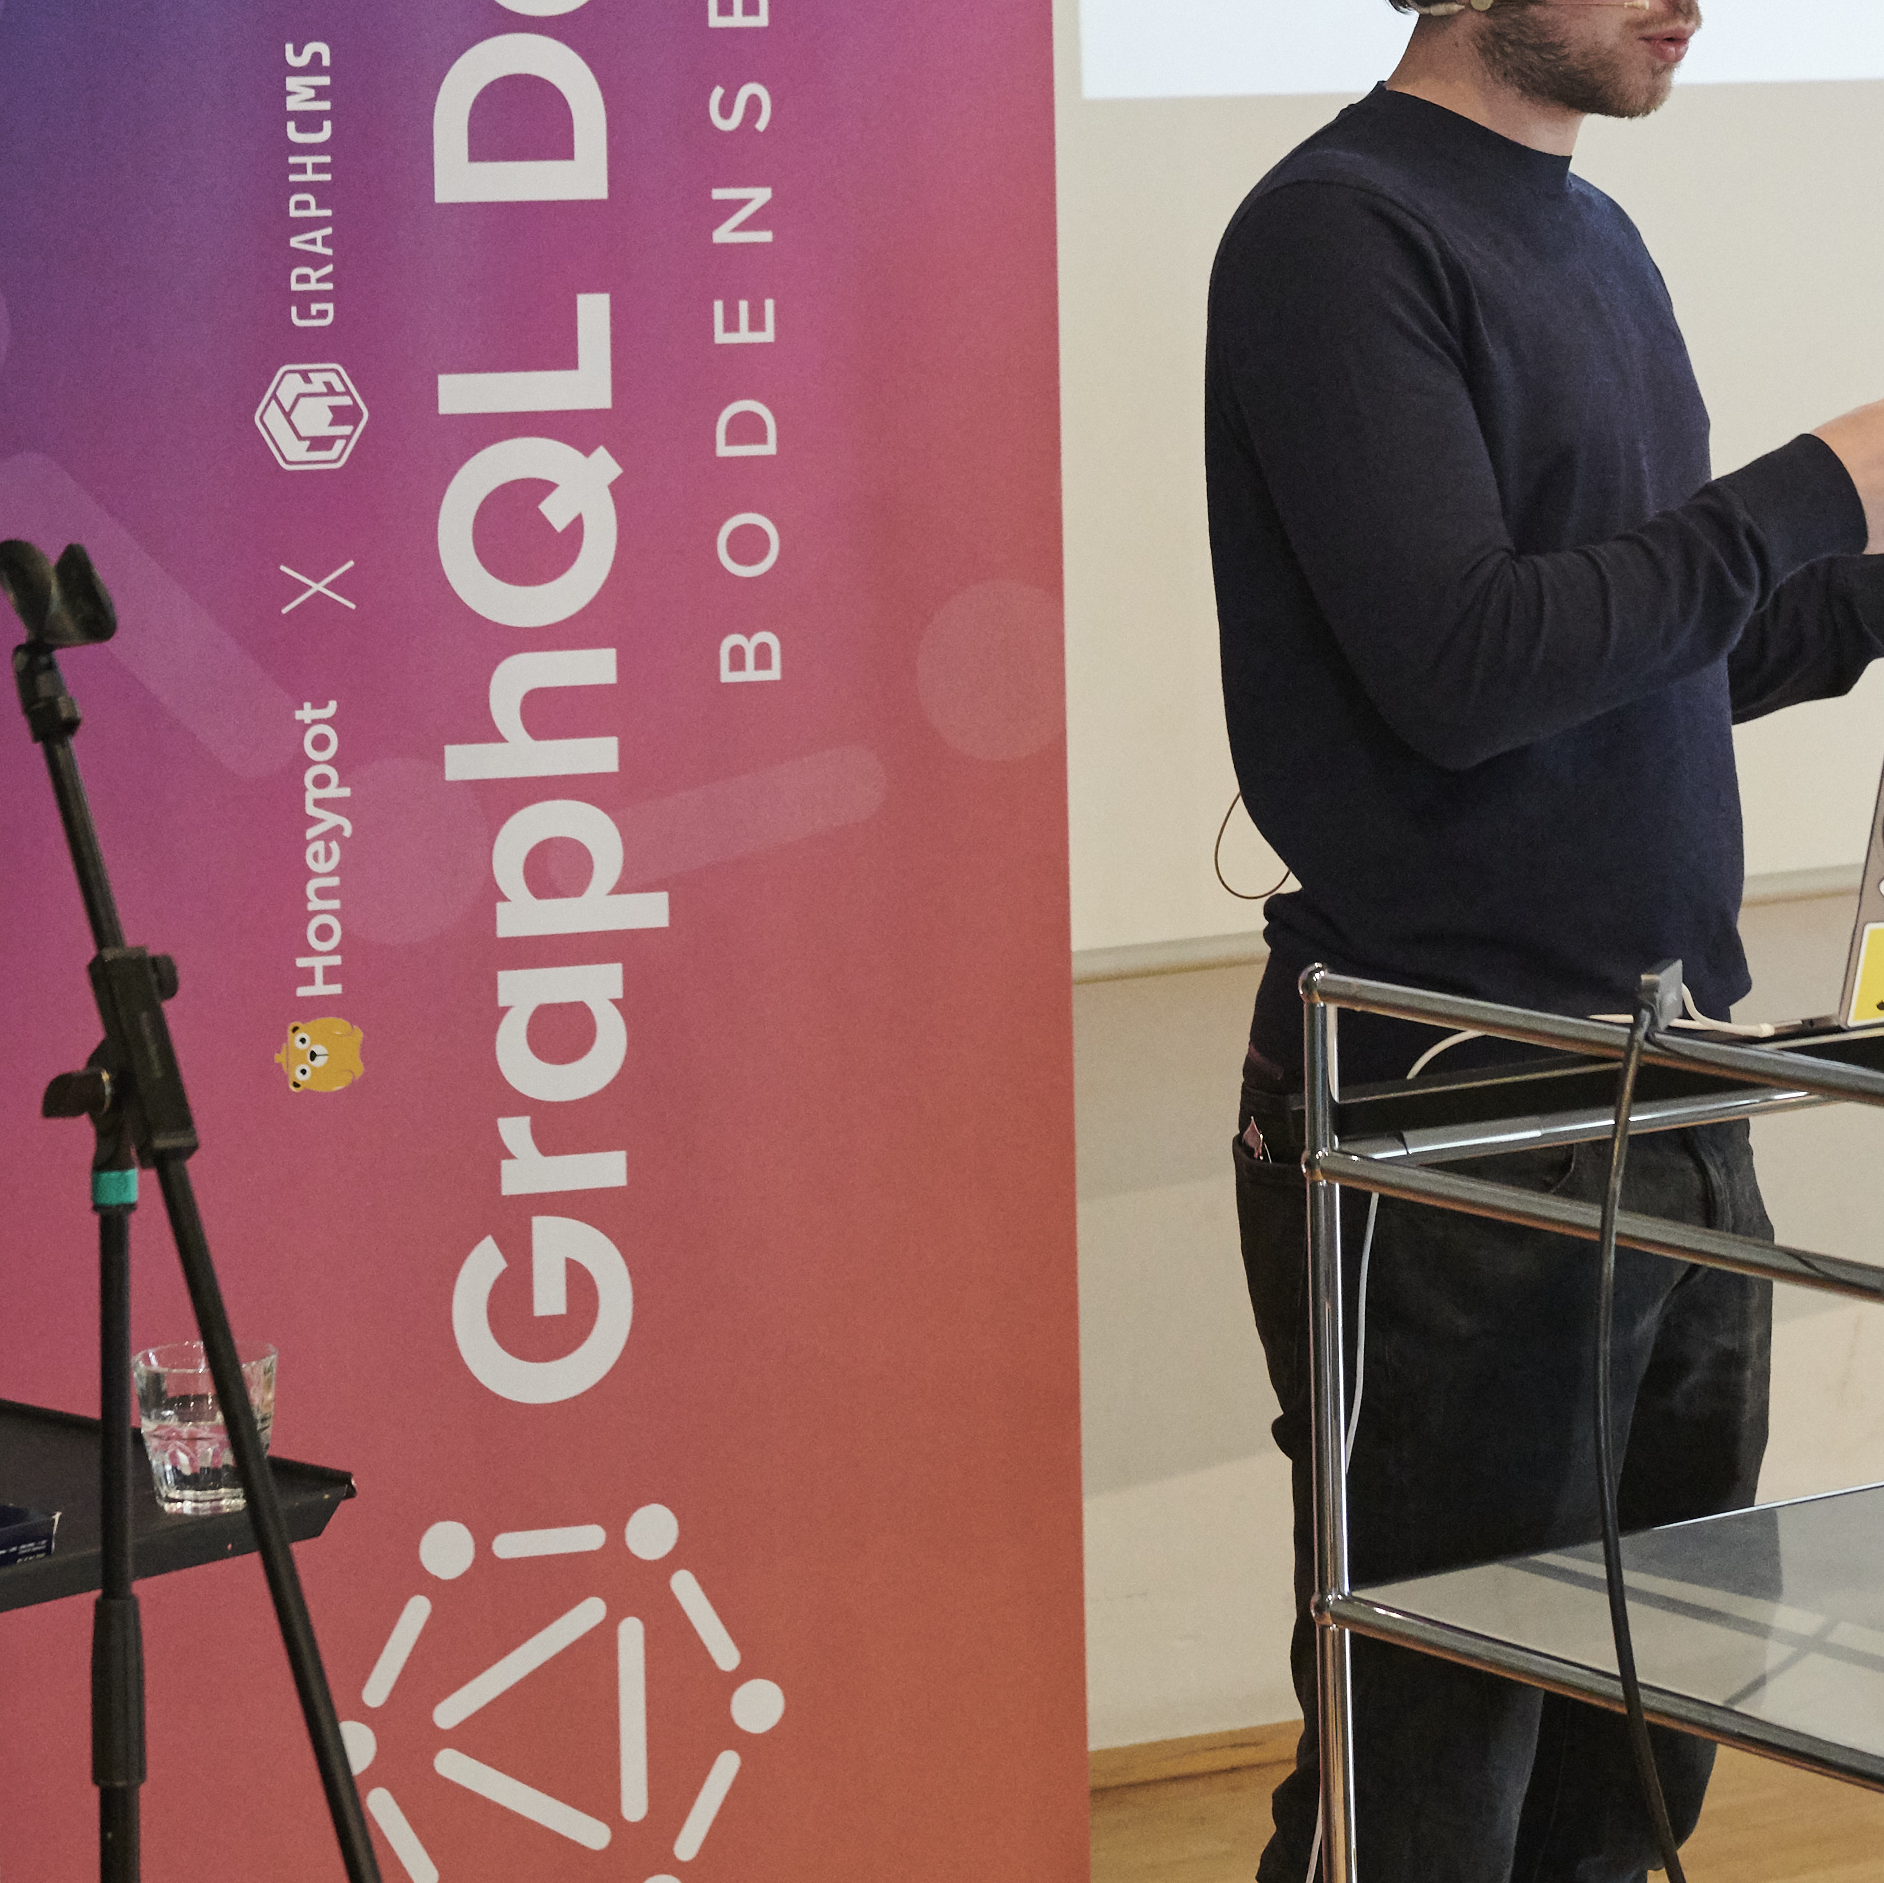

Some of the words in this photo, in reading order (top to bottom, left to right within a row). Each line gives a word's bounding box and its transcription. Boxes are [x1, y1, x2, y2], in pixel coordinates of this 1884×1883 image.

[285, 41, 335, 327] GRAPHCMS
[294, 700, 353, 997] Honeypot
[437, 292, 670, 1405] GraphQL
